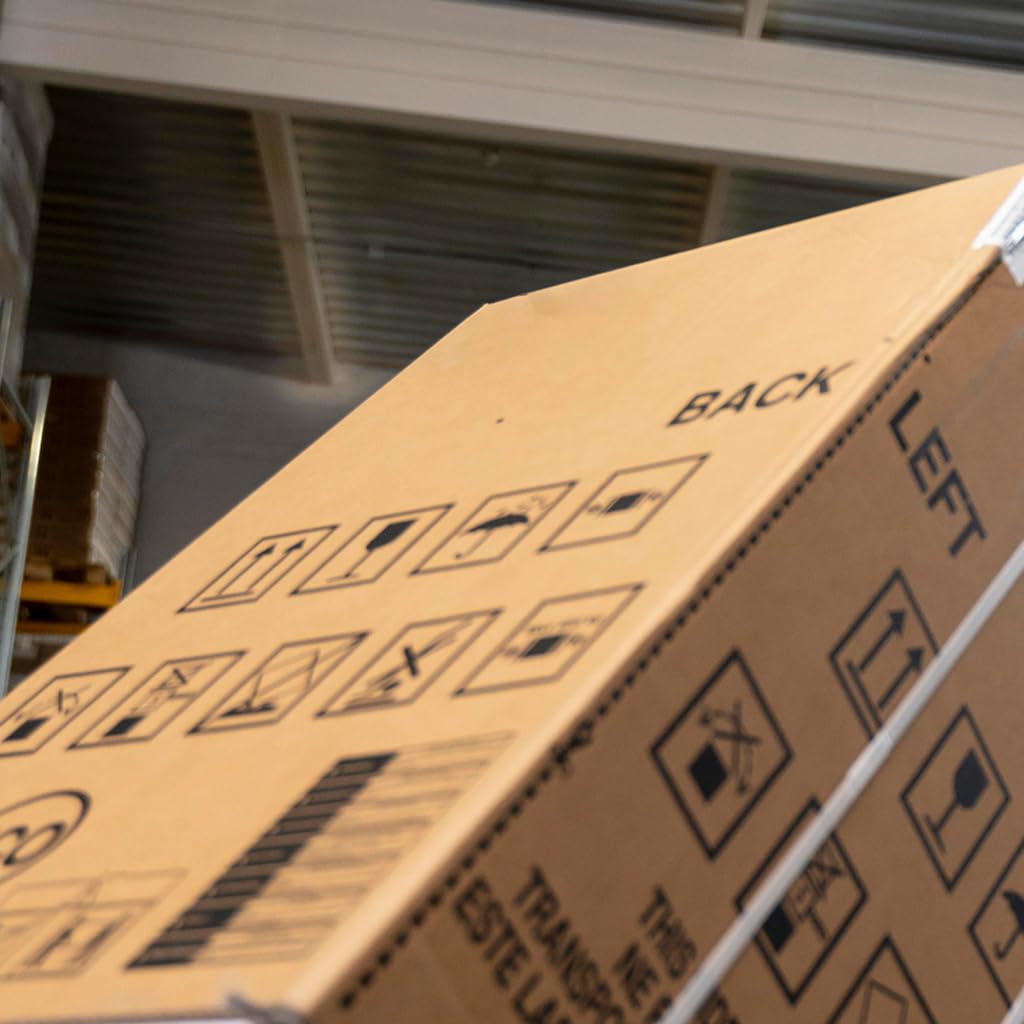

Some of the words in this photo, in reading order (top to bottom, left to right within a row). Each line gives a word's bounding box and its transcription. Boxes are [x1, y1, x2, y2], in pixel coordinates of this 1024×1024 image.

[668, 361, 856, 428] BACK
[888, 389, 988, 559] LEFT
[453, 878, 530, 989] ESTE
[613, 943, 659, 1008] NE
[639, 886, 697, 981] THIS
